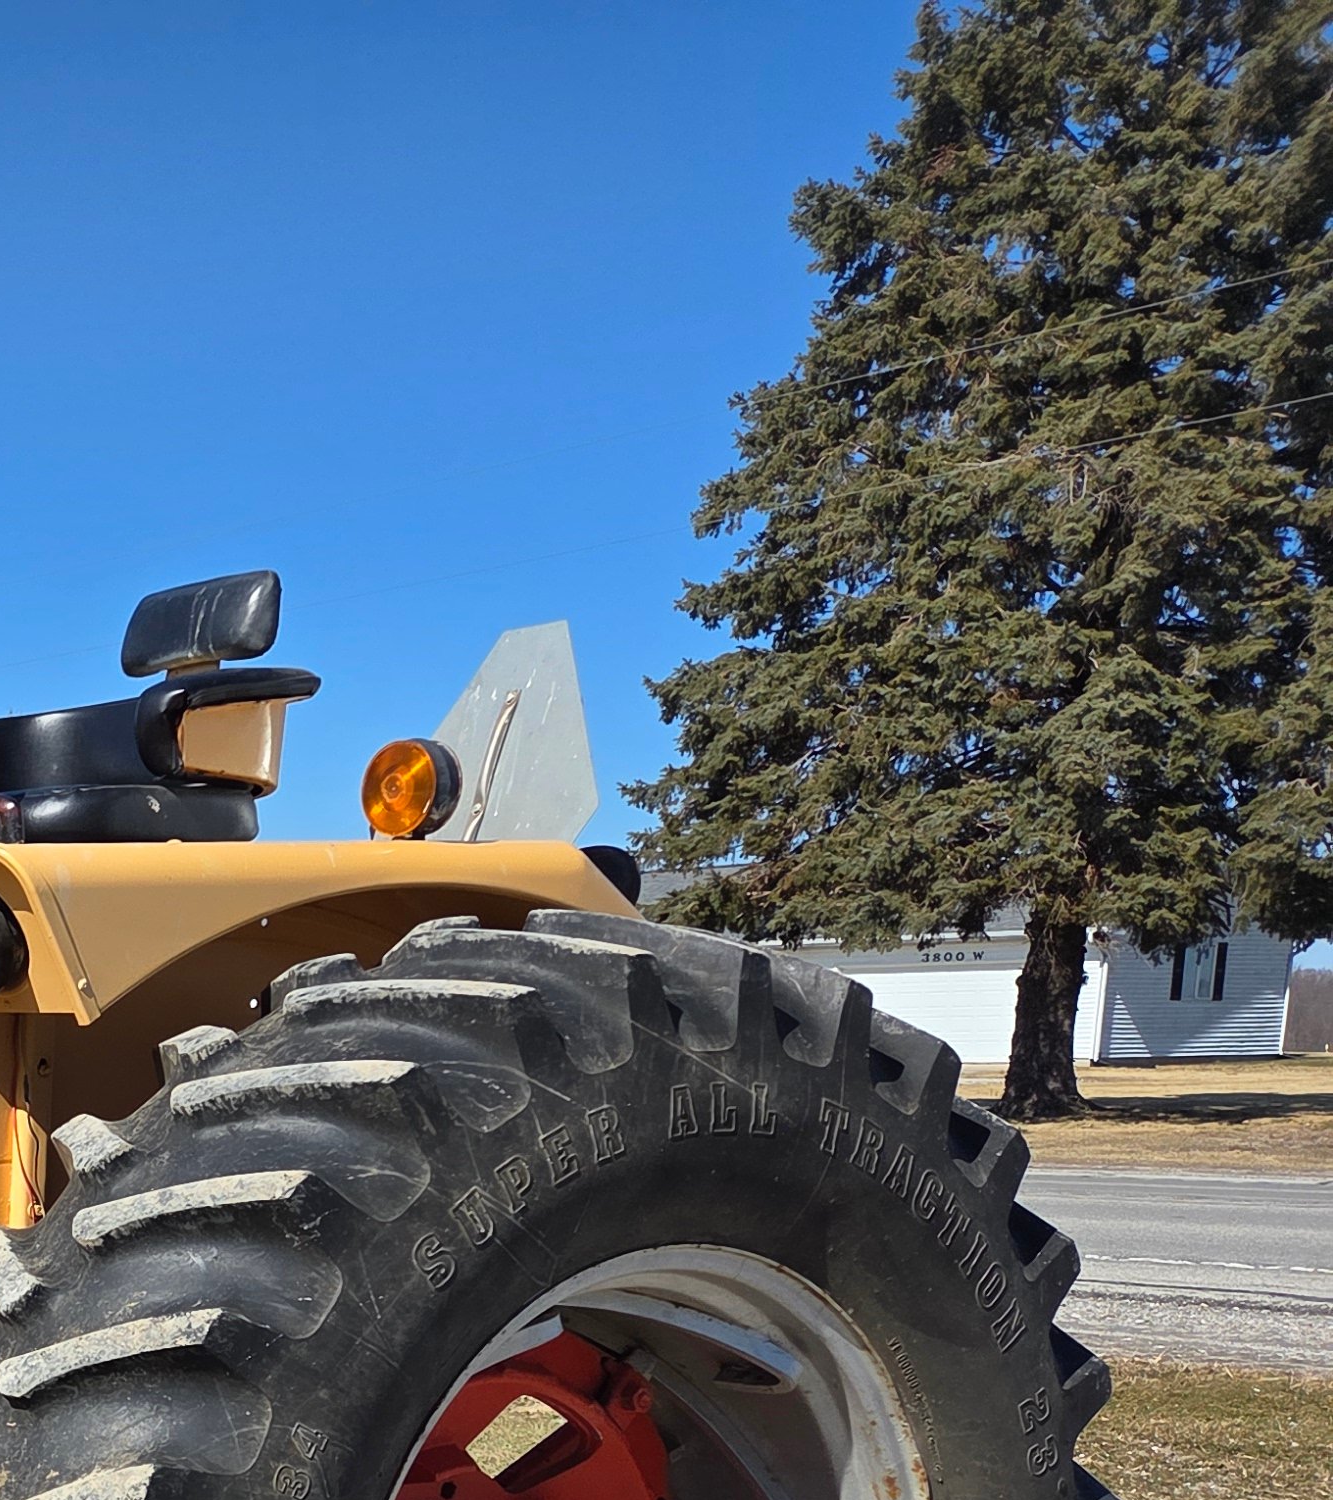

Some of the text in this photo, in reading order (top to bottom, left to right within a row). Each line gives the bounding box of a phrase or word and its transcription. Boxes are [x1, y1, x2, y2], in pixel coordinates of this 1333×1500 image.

[921, 951, 985, 963] 3800 W
[411, 1103, 627, 1289] SUPER
[668, 1081, 777, 1139] ALL
[819, 1096, 1026, 1355] TRACTION
